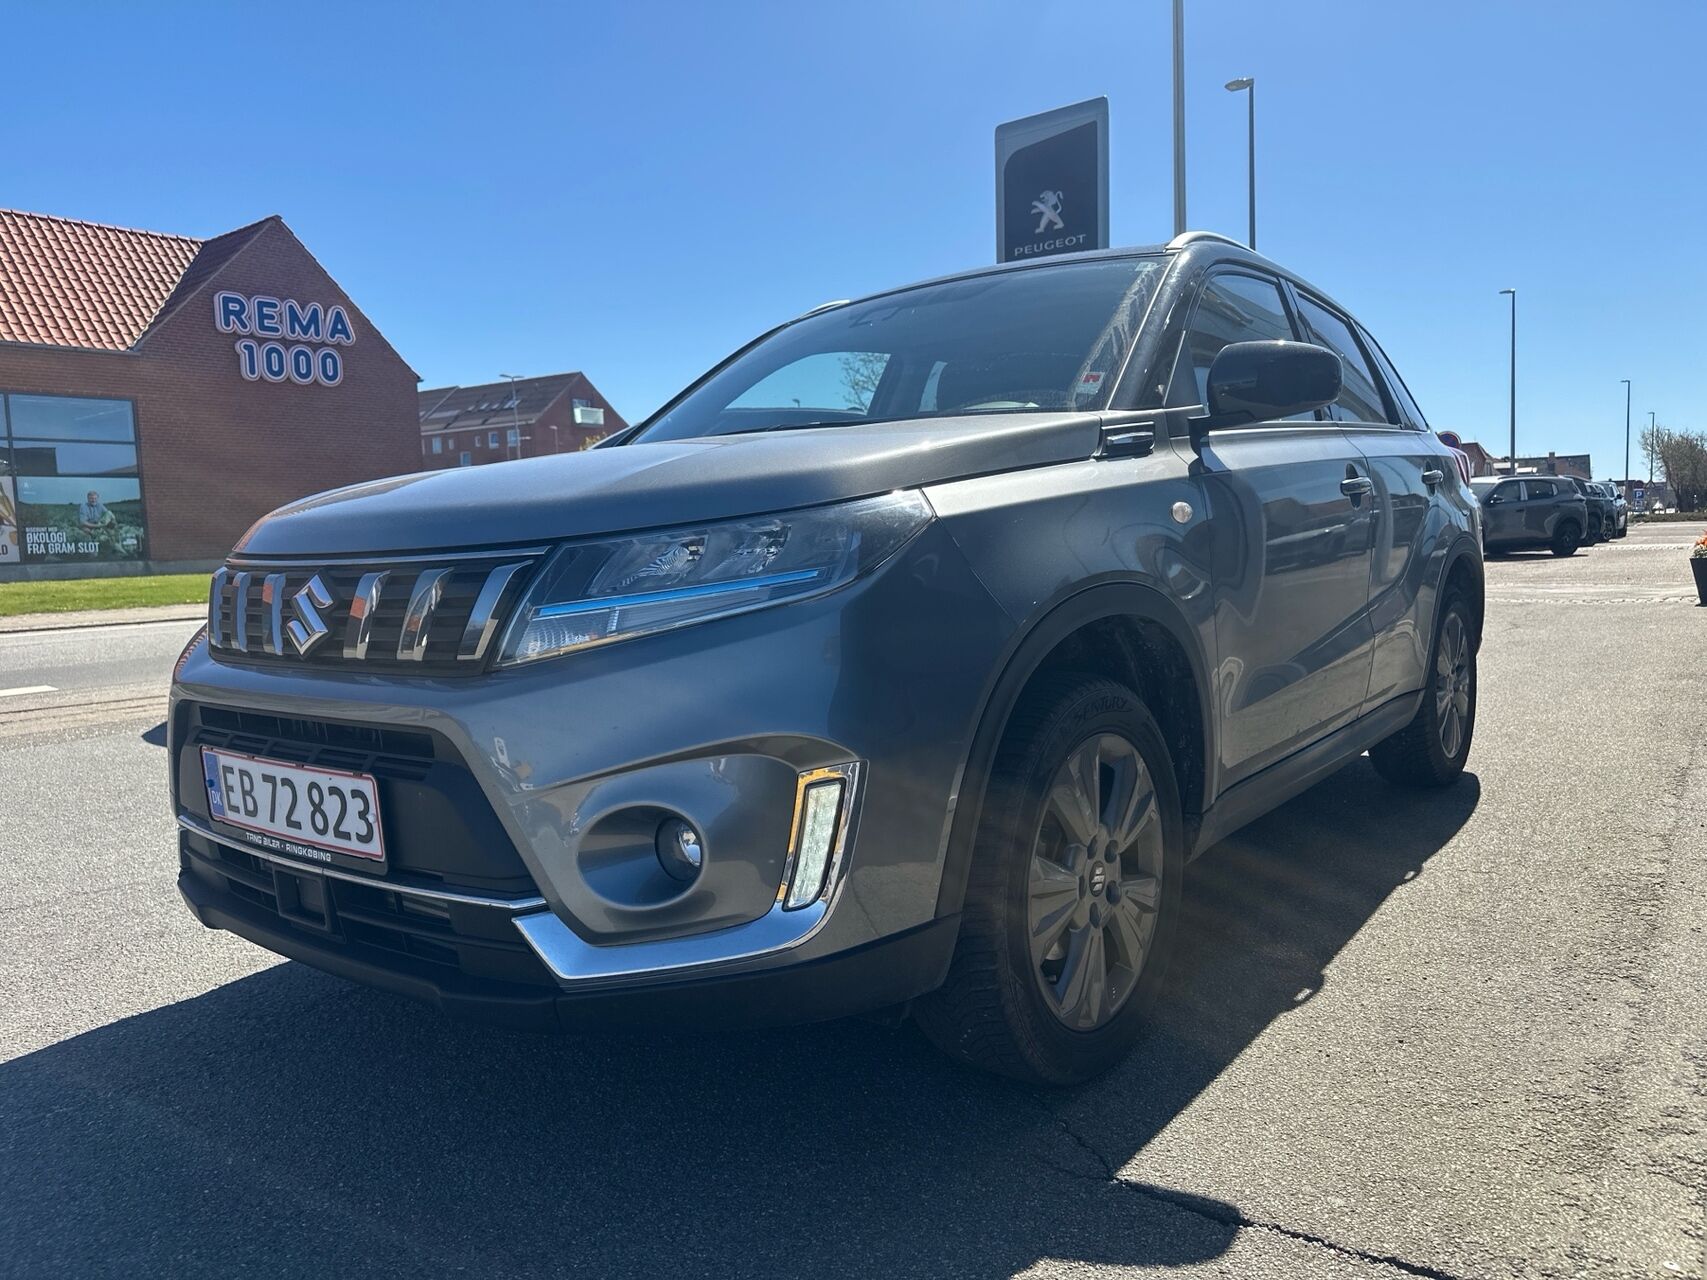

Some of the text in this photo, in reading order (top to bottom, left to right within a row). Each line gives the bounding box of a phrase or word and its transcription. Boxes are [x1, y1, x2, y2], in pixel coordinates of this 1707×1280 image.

[1014, 234, 1087, 256] PEUGEOT
[217, 292, 355, 345] REMA
[237, 340, 342, 386] 1000
[26, 532, 66, 543] ØKOLOGI
[27, 542, 99, 554] FRA GRAM SLOT
[211, 791, 223, 806] DK
[285, 843, 332, 862] RINGKØBING
